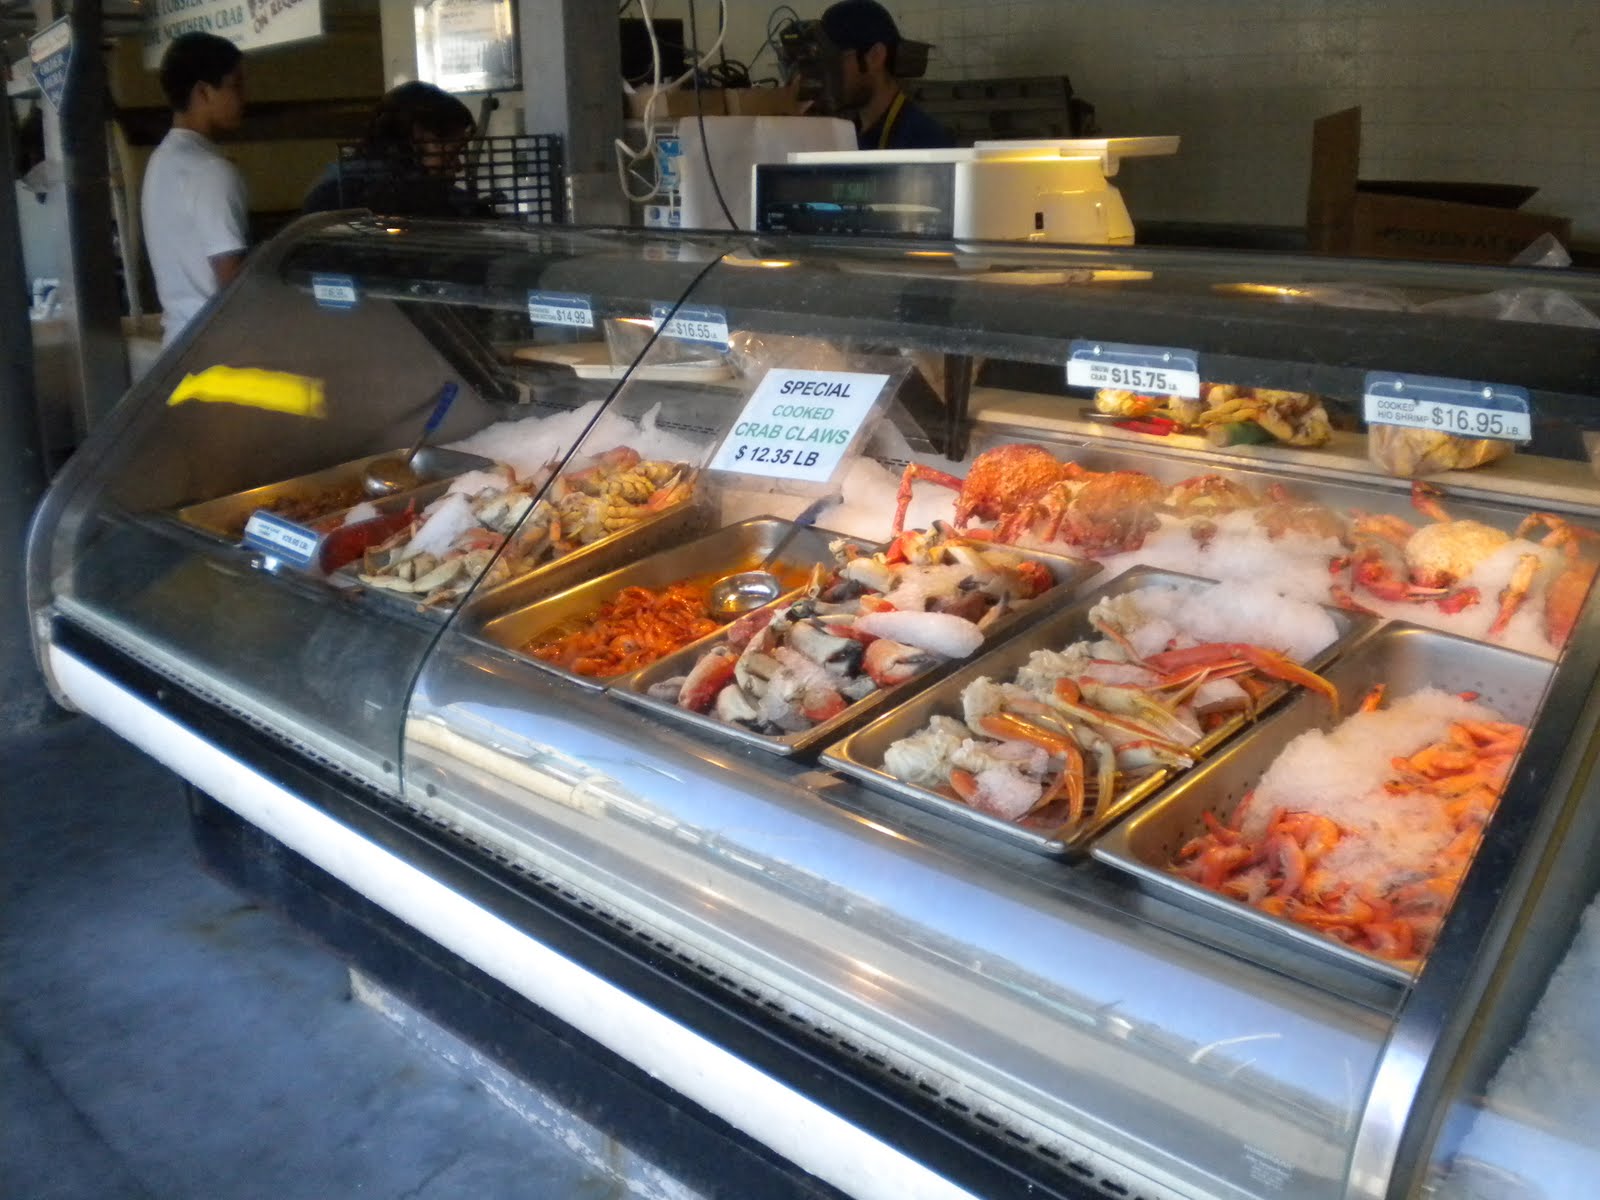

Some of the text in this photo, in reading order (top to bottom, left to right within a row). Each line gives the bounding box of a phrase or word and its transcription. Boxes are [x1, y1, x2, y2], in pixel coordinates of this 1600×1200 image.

[215, 6, 244, 29] CRAB
[556, 309, 586, 324] $14.99
[676, 322, 711, 339] $16.55
[1111, 368, 1168, 390] $15.75
[780, 380, 851, 398] SPECIAL
[772, 404, 835, 421] COOKED
[1377, 400, 1415, 412] COOKED
[1395, 413, 1429, 423] SHRIMP
[1432, 407, 1503, 435] $16.95
[734, 422, 850, 445] CRAB CLAWS
[735, 445, 820, 467] $ 12.35 LB
